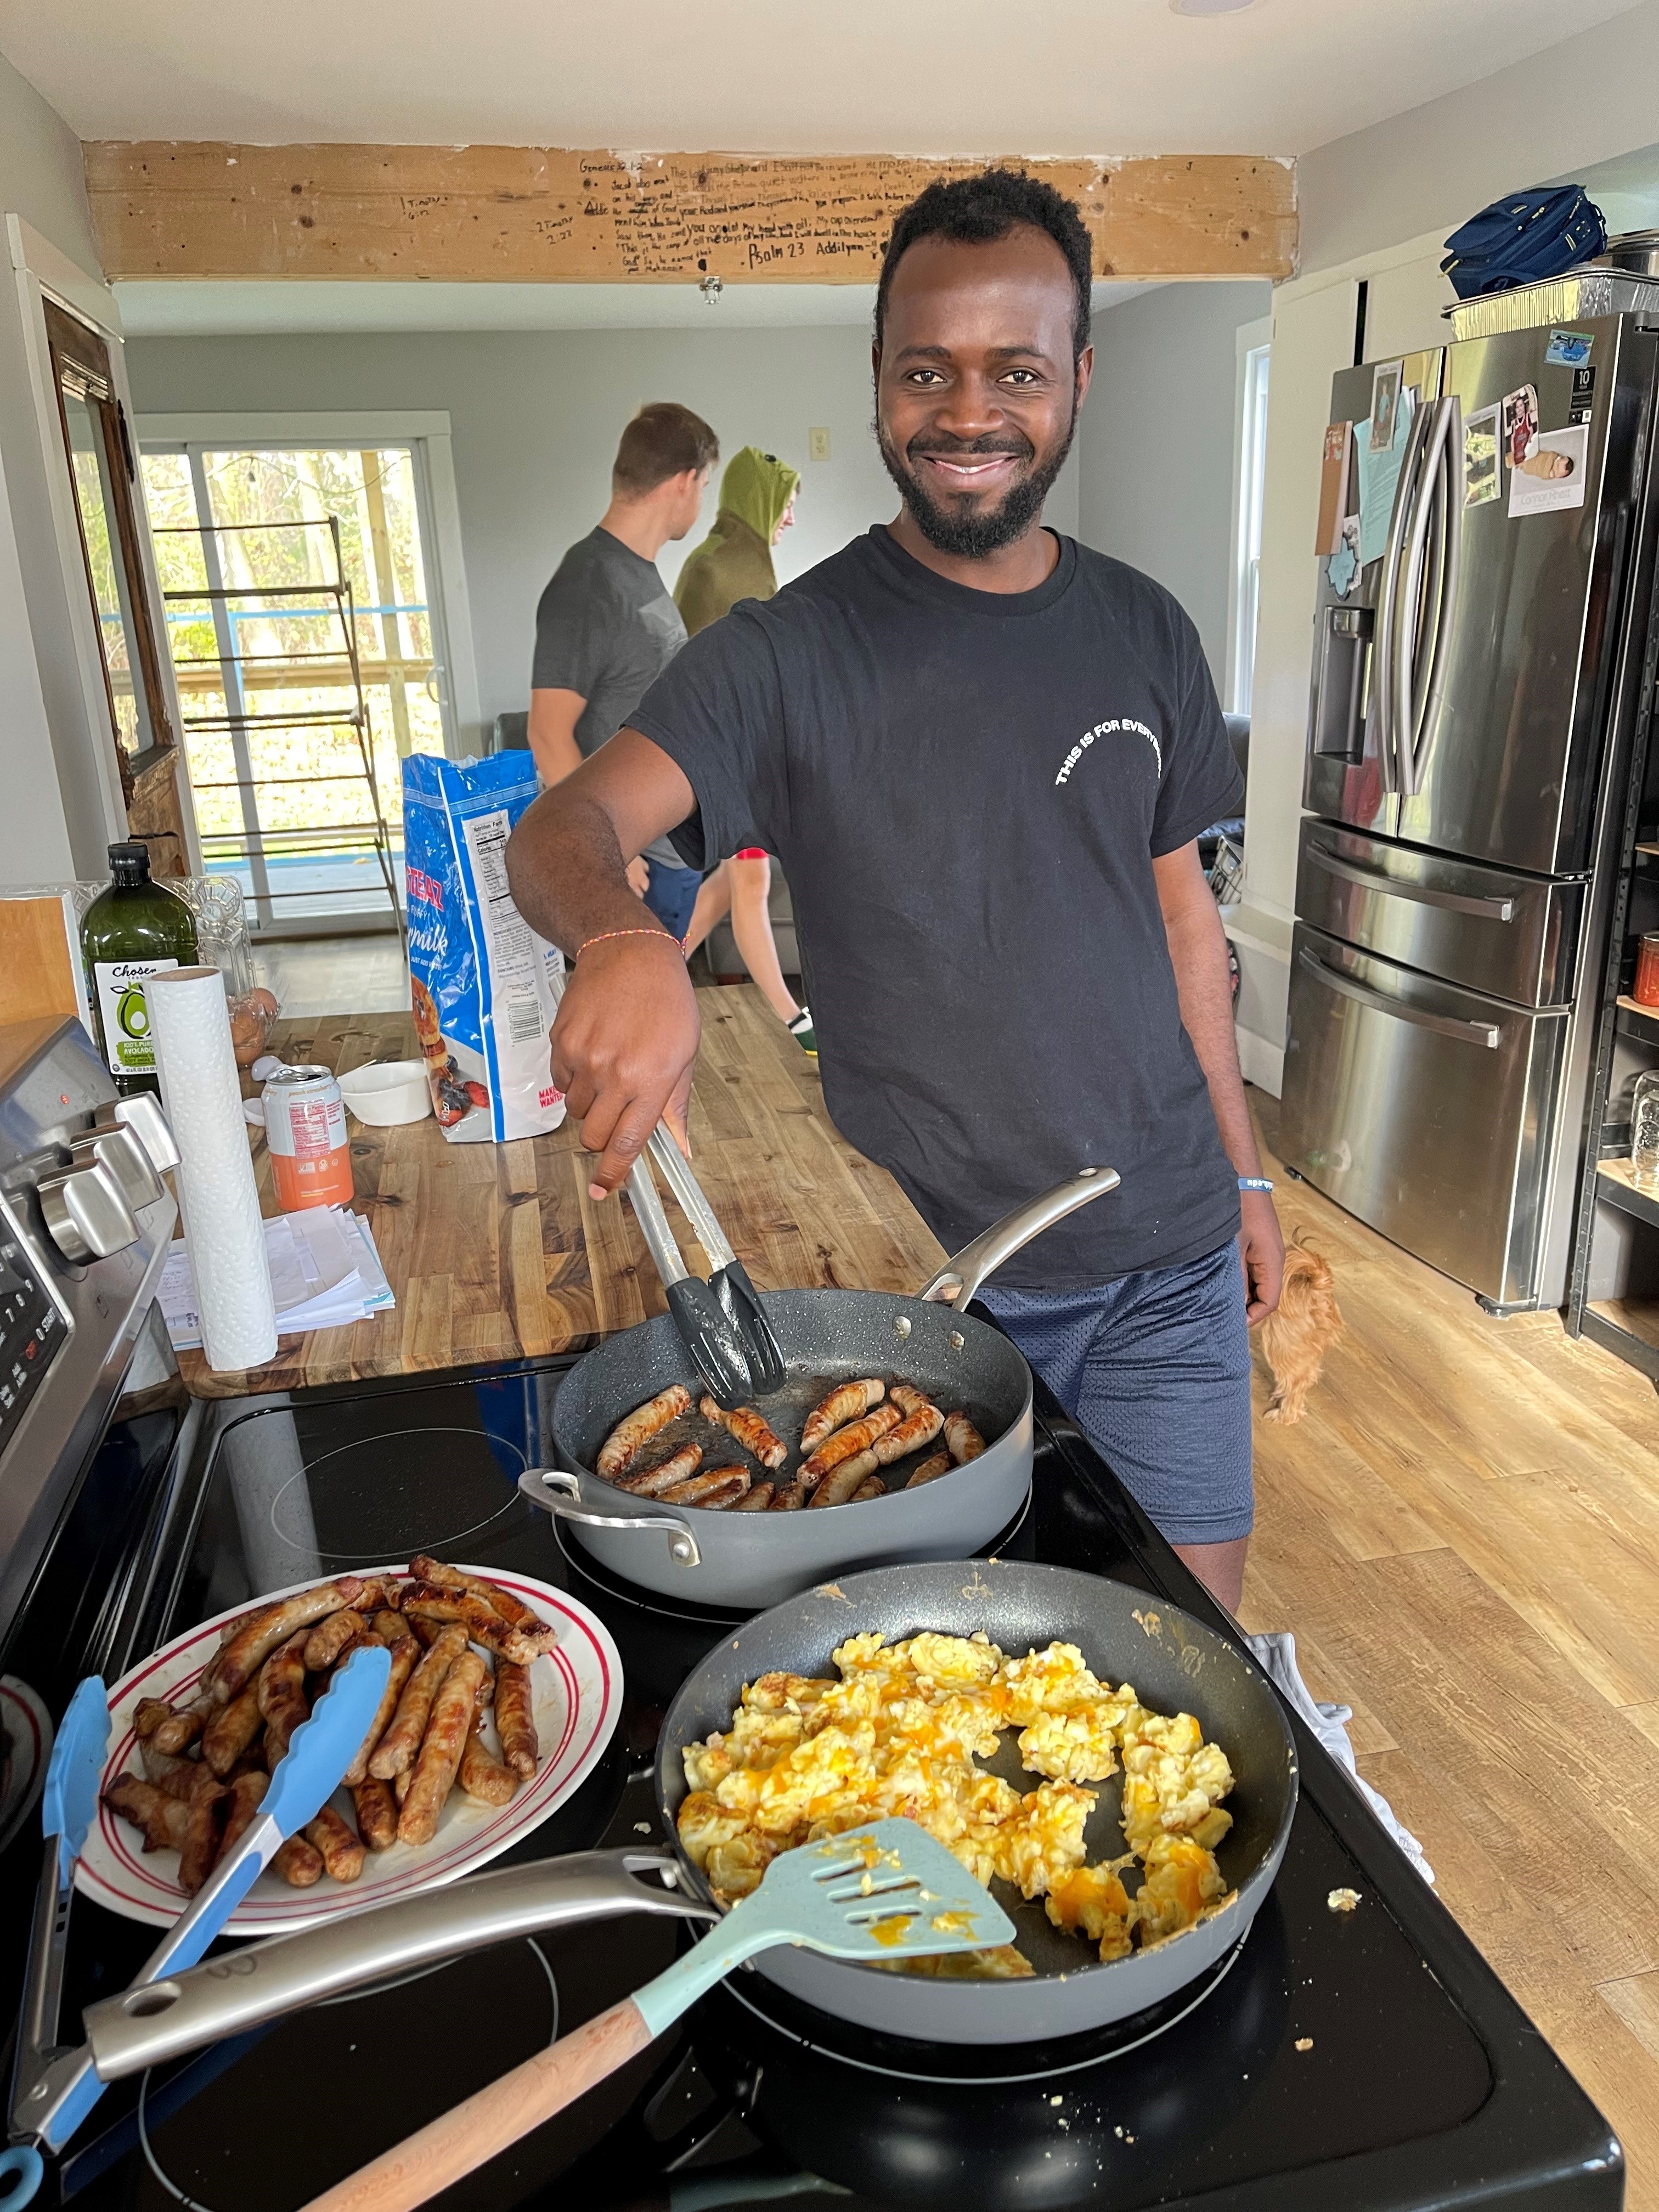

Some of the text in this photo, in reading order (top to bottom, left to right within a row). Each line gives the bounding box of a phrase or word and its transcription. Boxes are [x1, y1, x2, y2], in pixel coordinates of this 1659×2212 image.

[686, 223, 704, 240] you
[749, 243, 783, 269] Psalm
[787, 242, 805, 258] 23
[1579, 370, 1590, 385] 10
[1055, 746, 1082, 786] THIS
[1079, 732, 1095, 748] IS
[1093, 719, 1120, 738] FOR
[112, 964, 157, 977] Chosen
[124, 1047, 154, 1055] AVOCADO
[15, 1293, 25, 1307] 8
[25, 1278, 34, 1293] 9
[36, 1327, 45, 1341] 0
[42, 1307, 57, 1333] START
